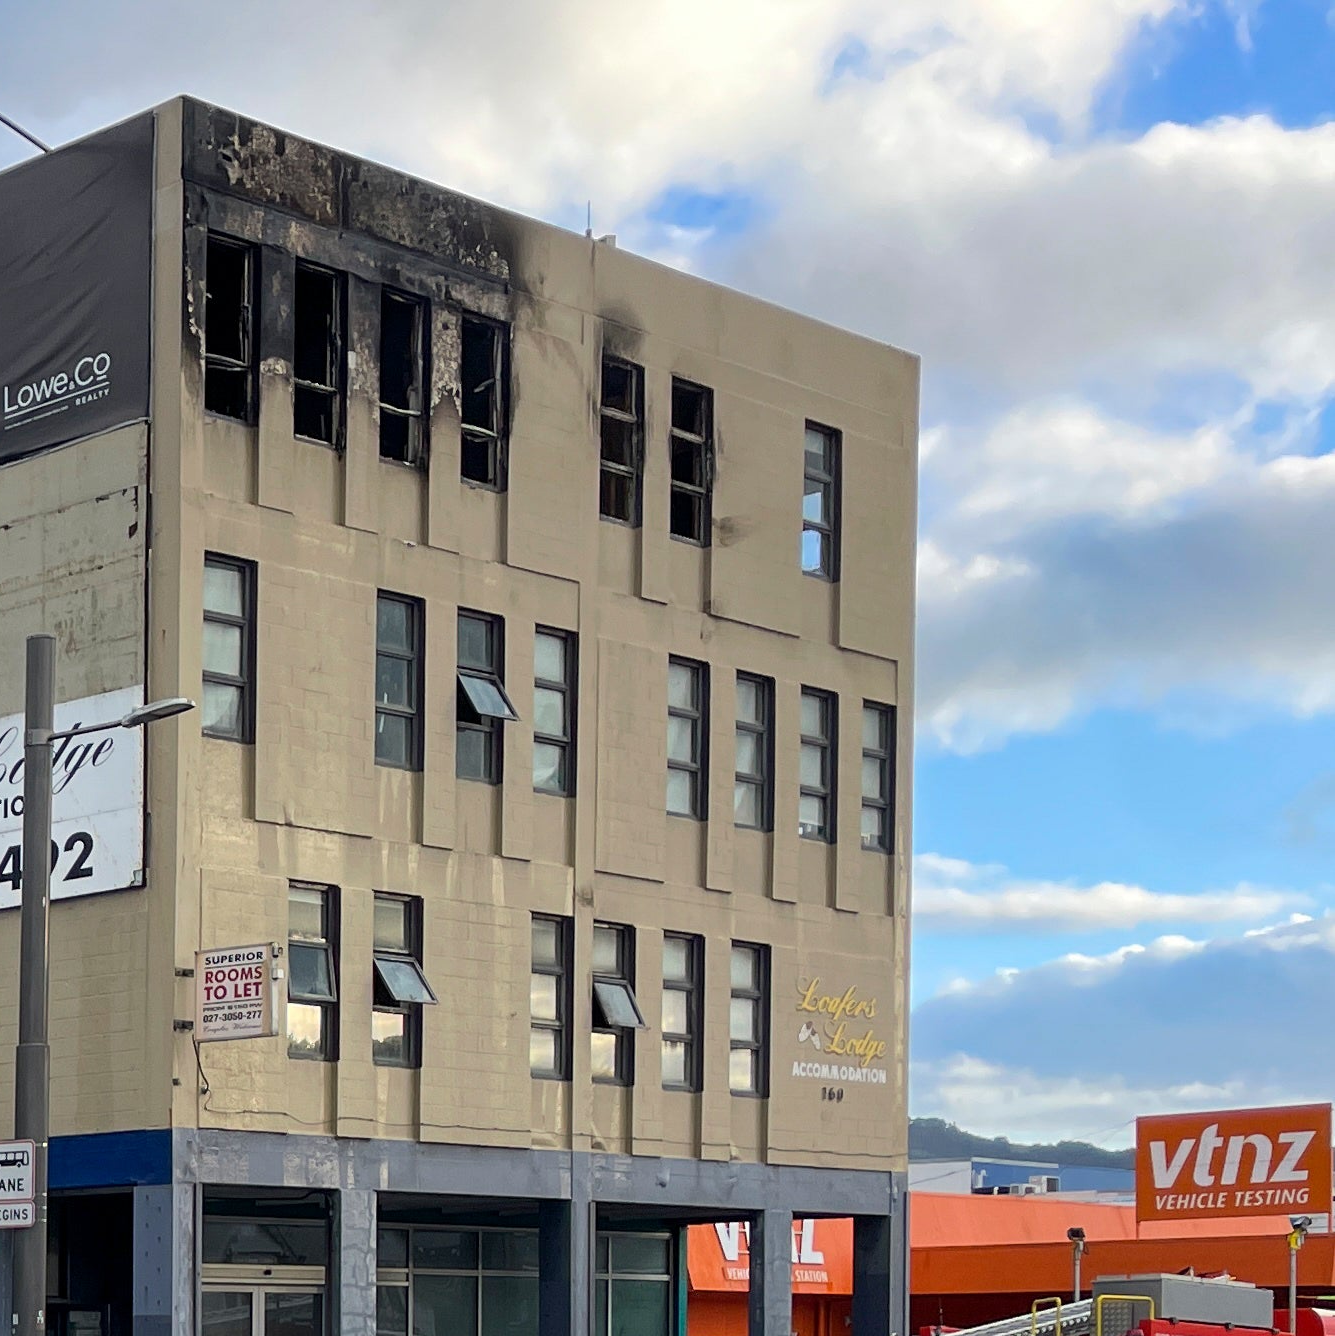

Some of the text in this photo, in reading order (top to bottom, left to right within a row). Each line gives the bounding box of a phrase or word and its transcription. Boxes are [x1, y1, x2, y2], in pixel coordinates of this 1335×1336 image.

[75, 388, 110, 406] REALTY
[205, 951, 263, 965] SUPERIOR
[205, 966, 262, 984] ROOMS
[204, 982, 262, 1001] TO LET
[795, 976, 876, 1020] Loafers
[824, 1021, 886, 1067] Lodge
[792, 1061, 887, 1084] ACCOMMODATION
[1149, 1123, 1317, 1189] vtnz
[1155, 1187, 1310, 1210] VEHICLE TESTING
[795, 1270, 828, 1282] STATION
